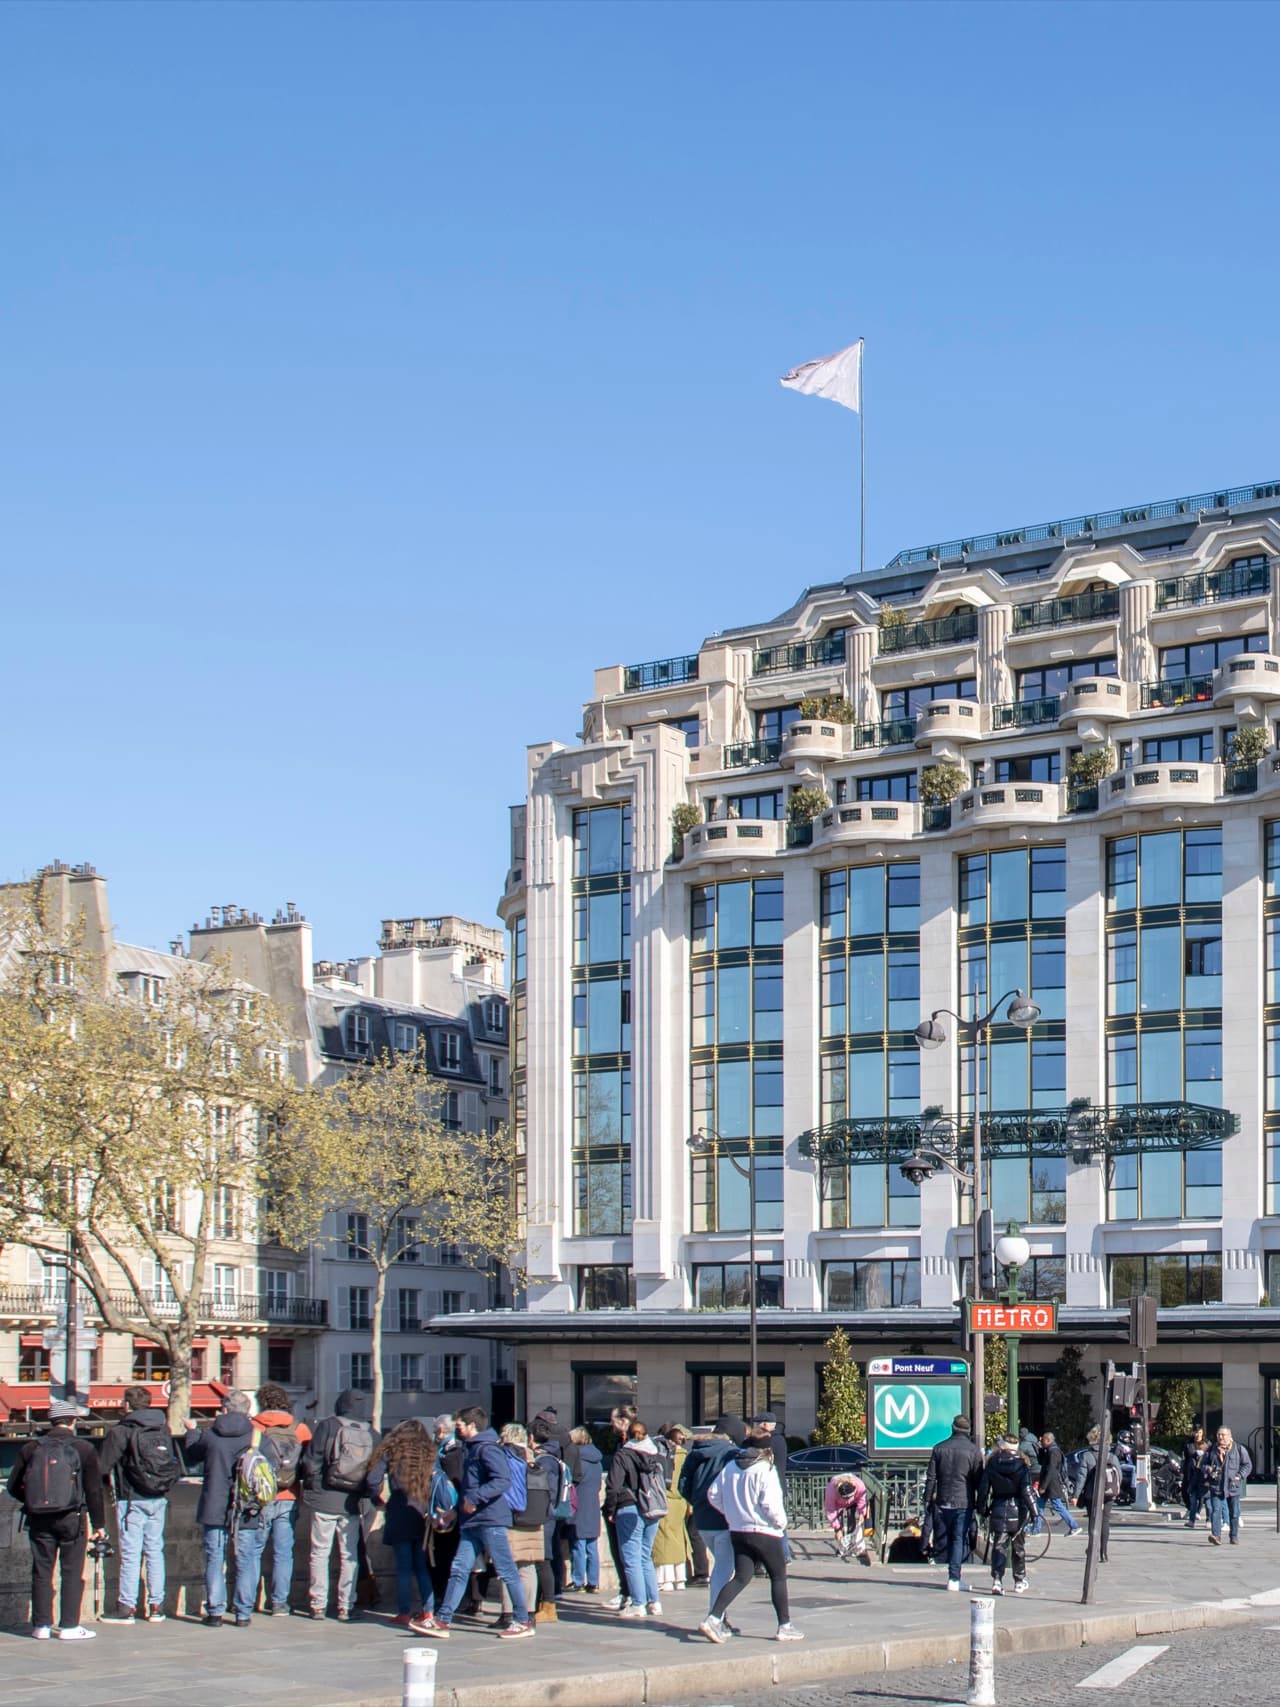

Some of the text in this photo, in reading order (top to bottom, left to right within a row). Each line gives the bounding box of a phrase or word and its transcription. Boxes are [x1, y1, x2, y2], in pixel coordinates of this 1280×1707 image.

[977, 1308, 1049, 1327] METRO
[894, 1363, 912, 1372] Pont
[914, 1363, 935, 1372] Neuf
[885, 1393, 916, 1425] M
